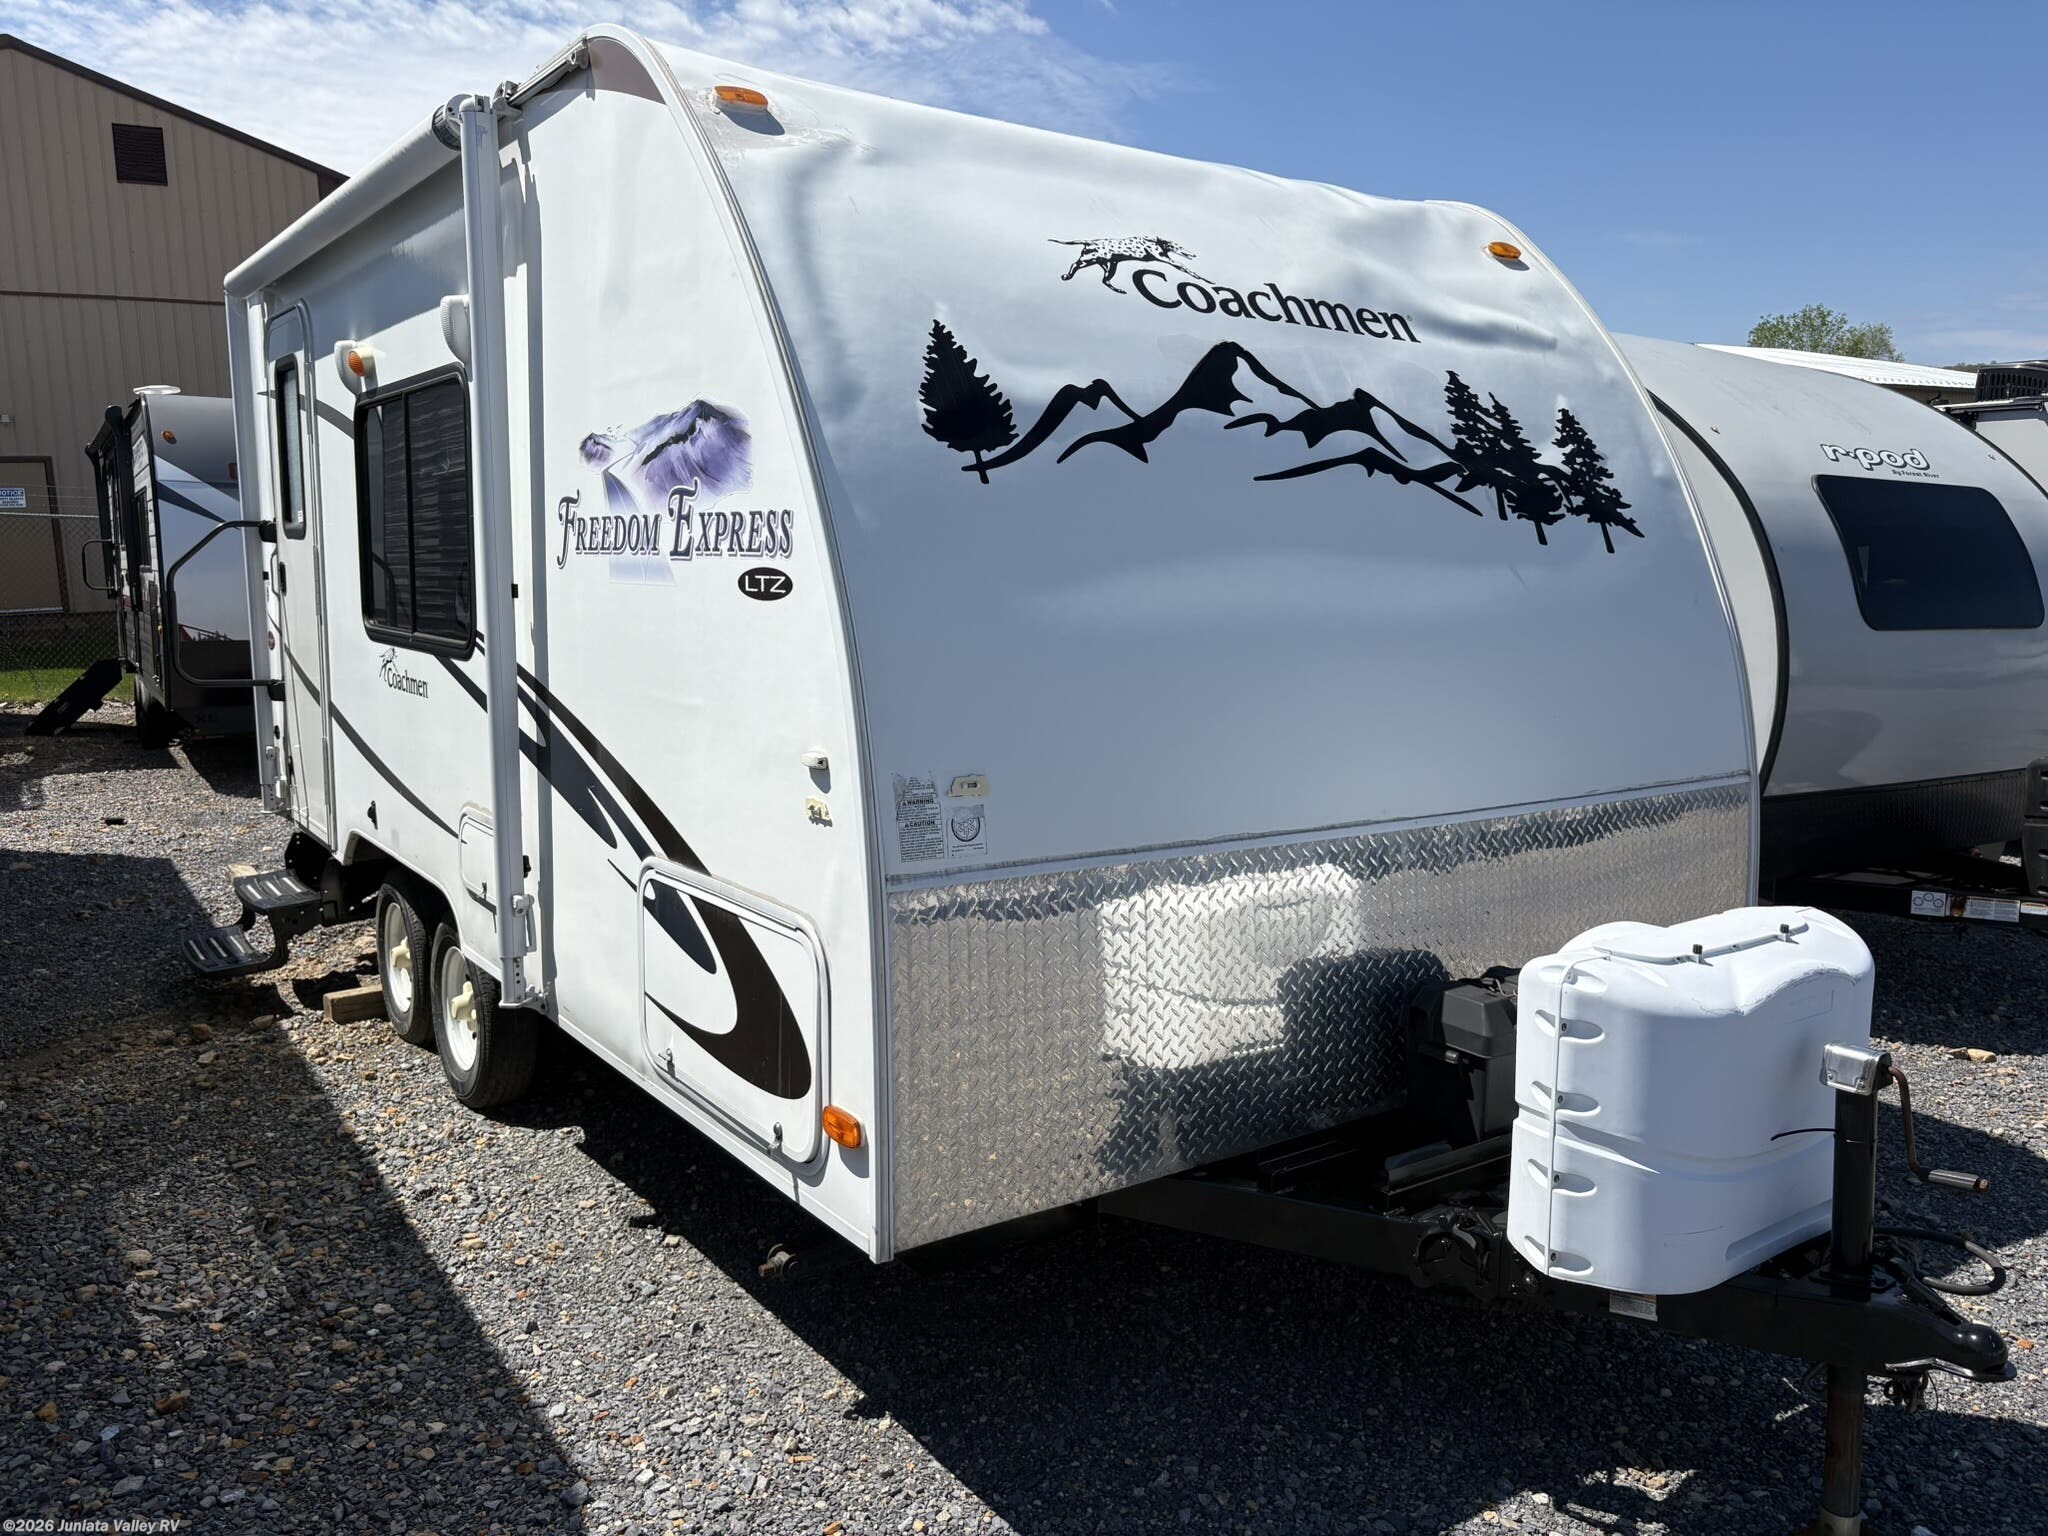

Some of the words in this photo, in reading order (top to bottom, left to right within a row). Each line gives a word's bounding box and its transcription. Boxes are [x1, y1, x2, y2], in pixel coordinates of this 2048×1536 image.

[1132, 268, 1421, 343] Coachmen
[745, 575, 787, 594] LTZ
[387, 667, 428, 698] Coachmen
